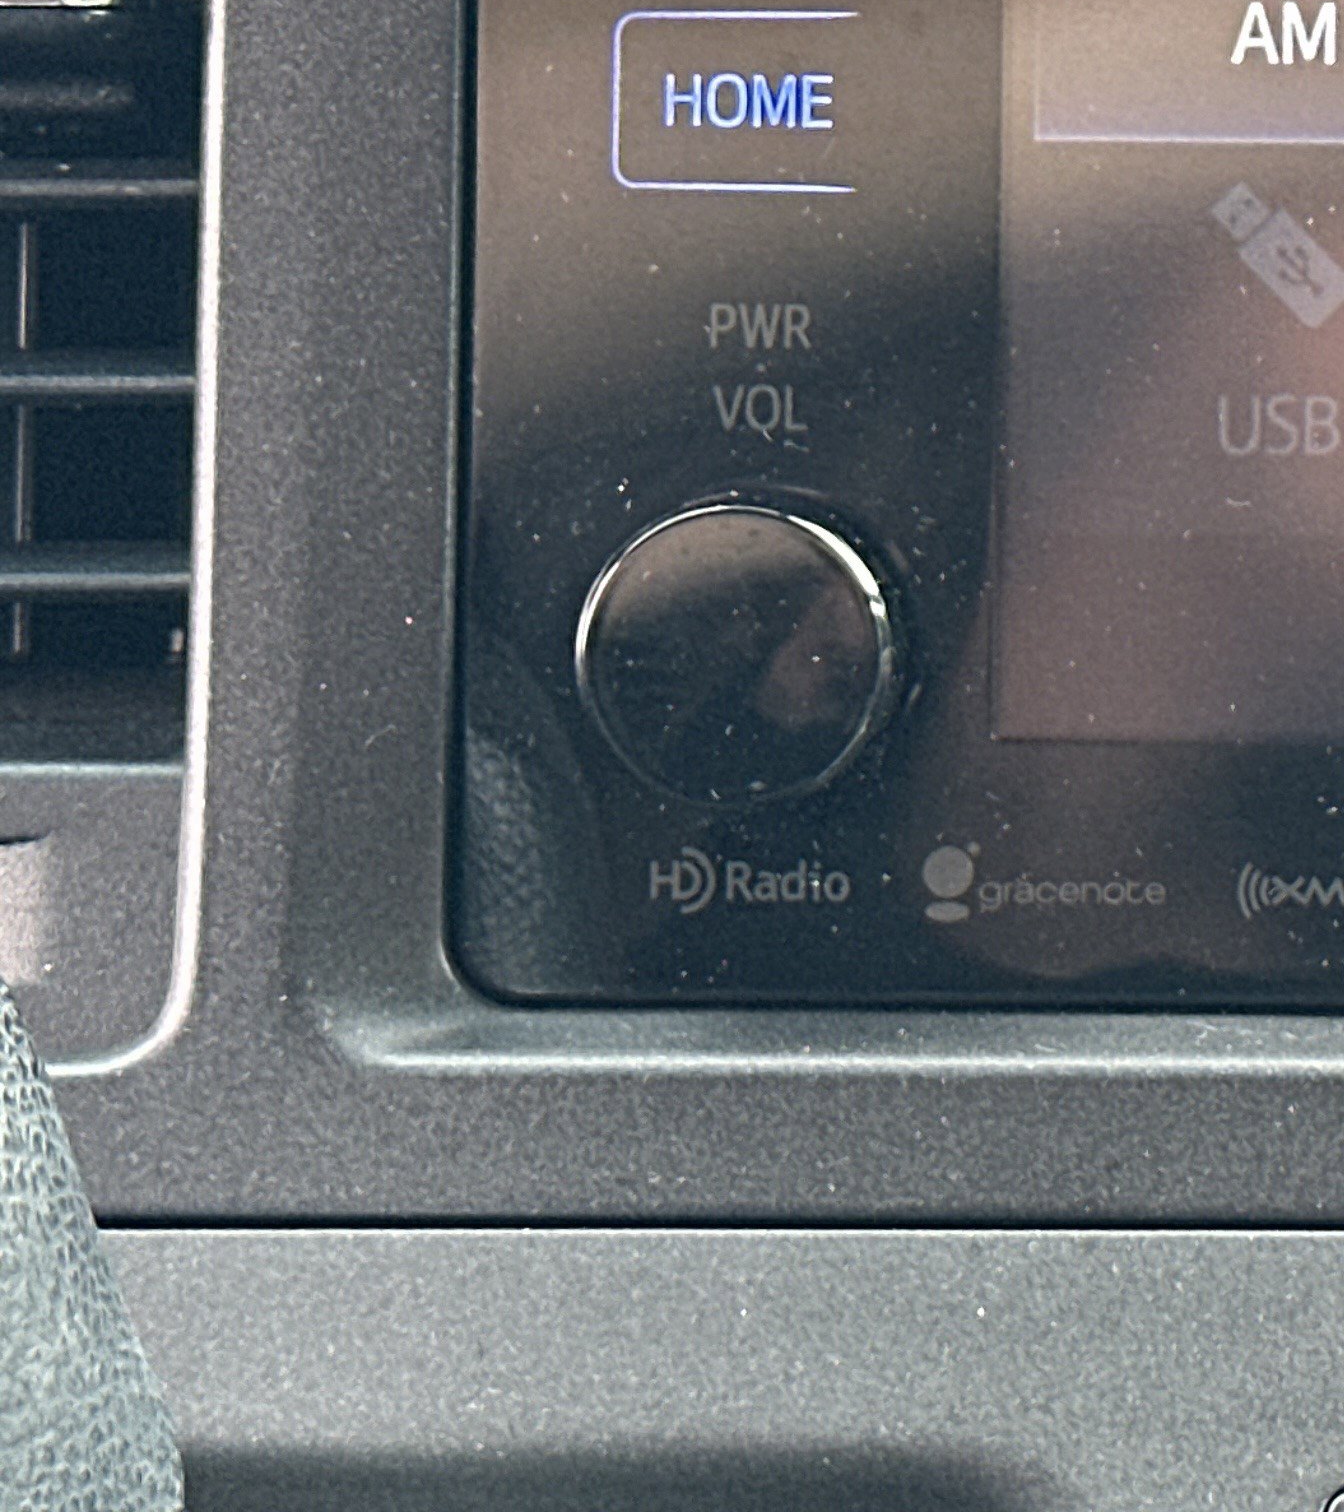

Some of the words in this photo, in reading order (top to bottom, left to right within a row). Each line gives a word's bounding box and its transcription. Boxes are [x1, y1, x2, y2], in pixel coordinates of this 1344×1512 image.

[1231, 1, 1337, 65] AM
[664, 74, 834, 129] HOME
[709, 304, 811, 349] PWR
[714, 384, 807, 432] VOL
[1217, 395, 1341, 456] USB
[725, 857, 850, 903] Radio
[979, 881, 1166, 914] gracenote
